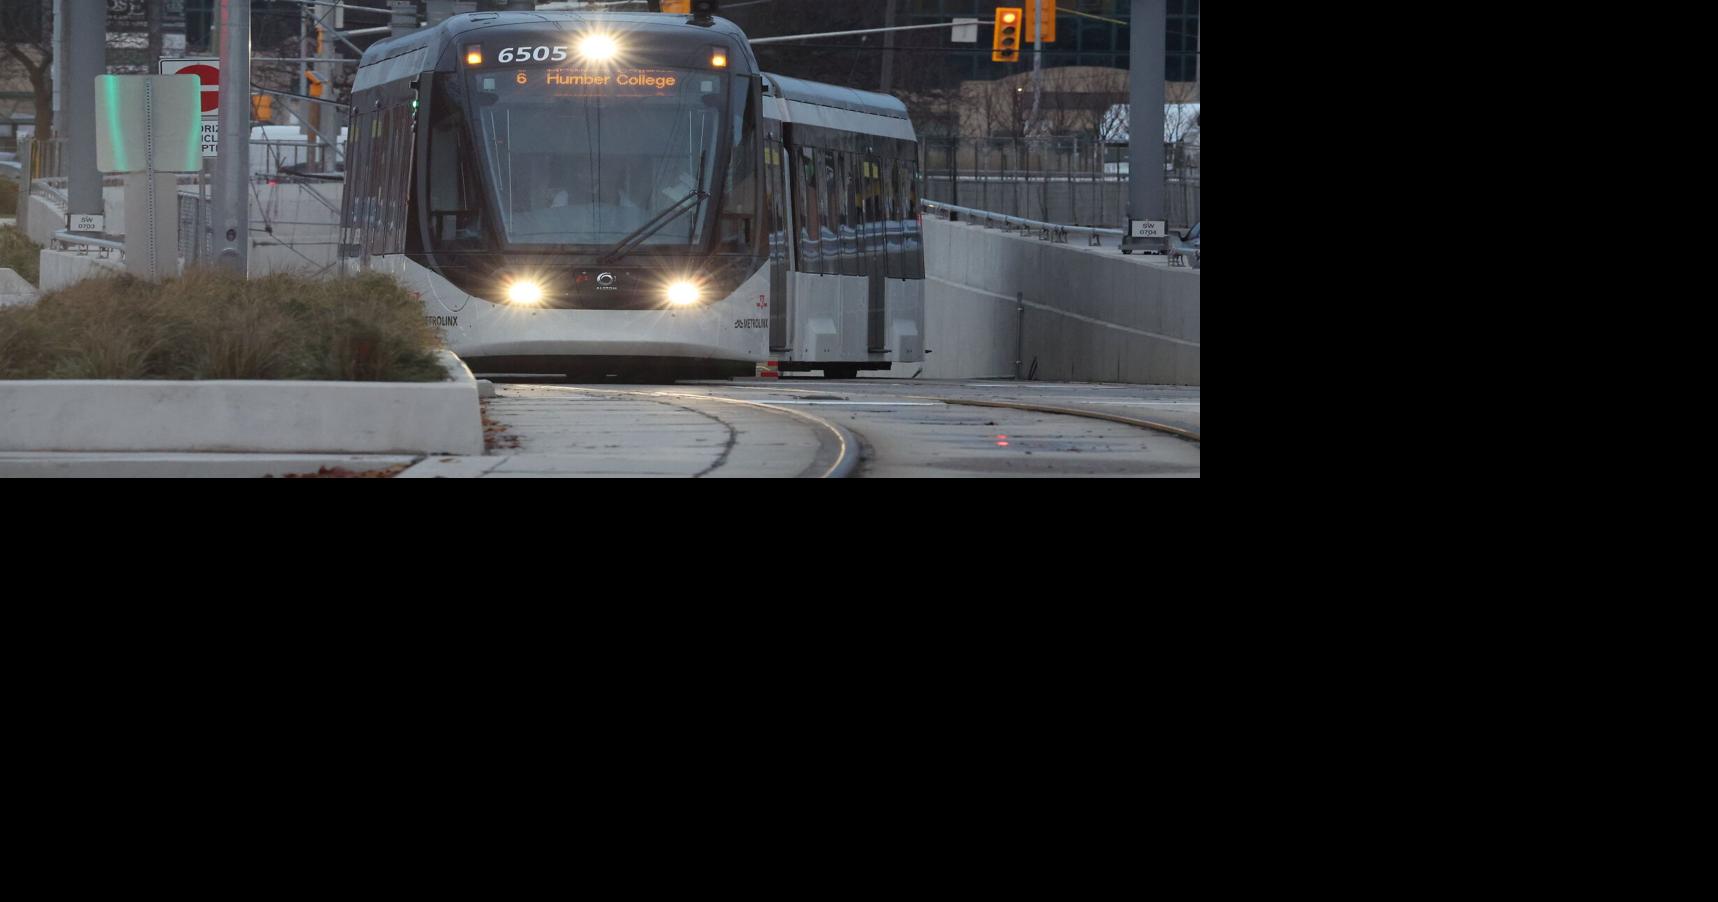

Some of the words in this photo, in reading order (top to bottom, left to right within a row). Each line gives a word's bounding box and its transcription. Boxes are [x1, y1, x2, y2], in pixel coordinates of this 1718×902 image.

[498, 46, 568, 63] 6505
[516, 72, 528, 85] 6
[546, 72, 611, 86] Humber
[616, 73, 676, 89] College
